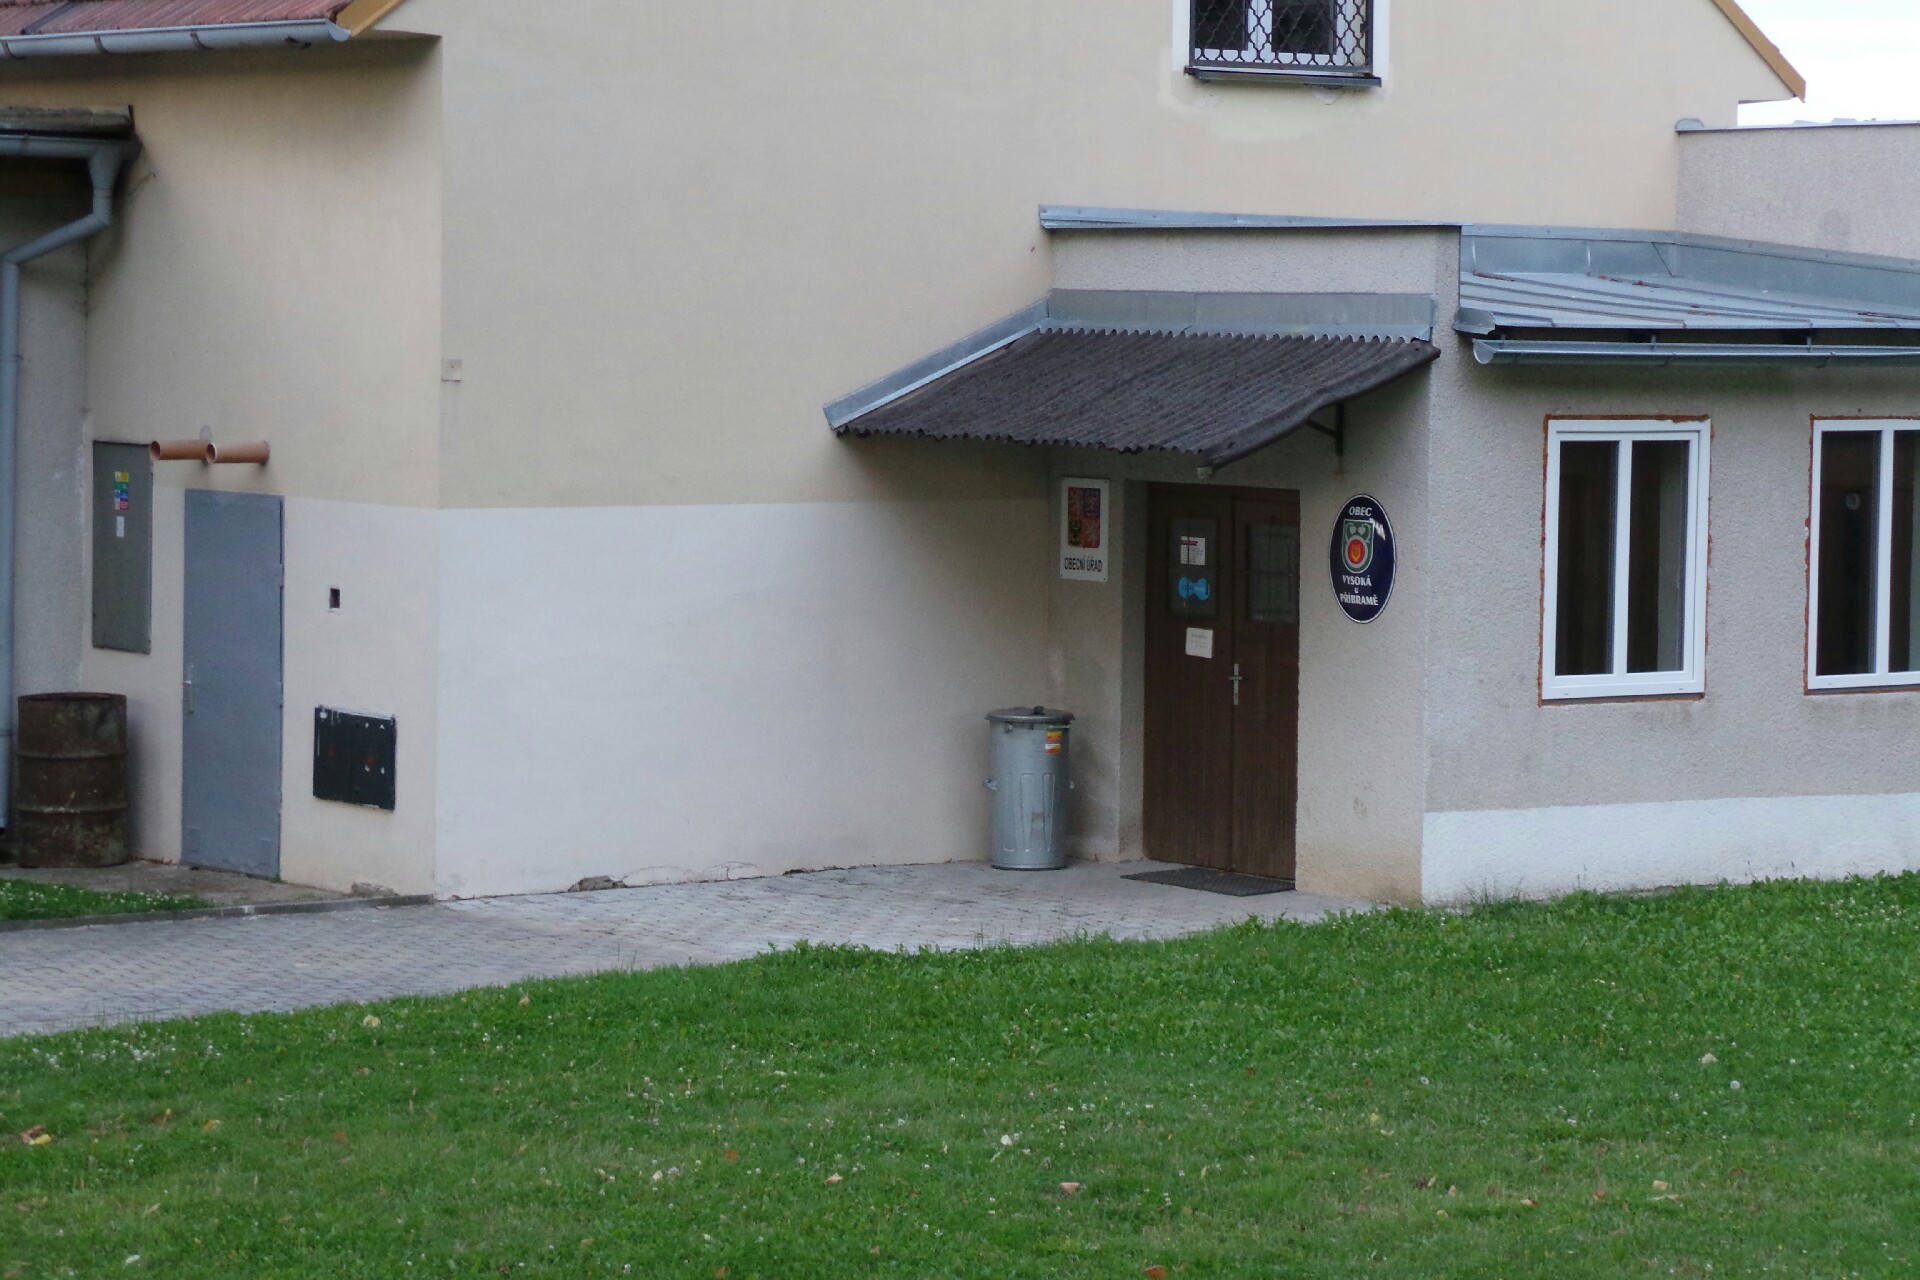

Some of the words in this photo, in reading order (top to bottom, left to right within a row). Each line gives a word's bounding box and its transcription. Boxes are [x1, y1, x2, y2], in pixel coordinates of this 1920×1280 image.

[1348, 506, 1373, 517] OBEC
[1342, 574, 1372, 587] VYSOKÁ
[1340, 592, 1379, 606] PŘÍBRAMĚ
